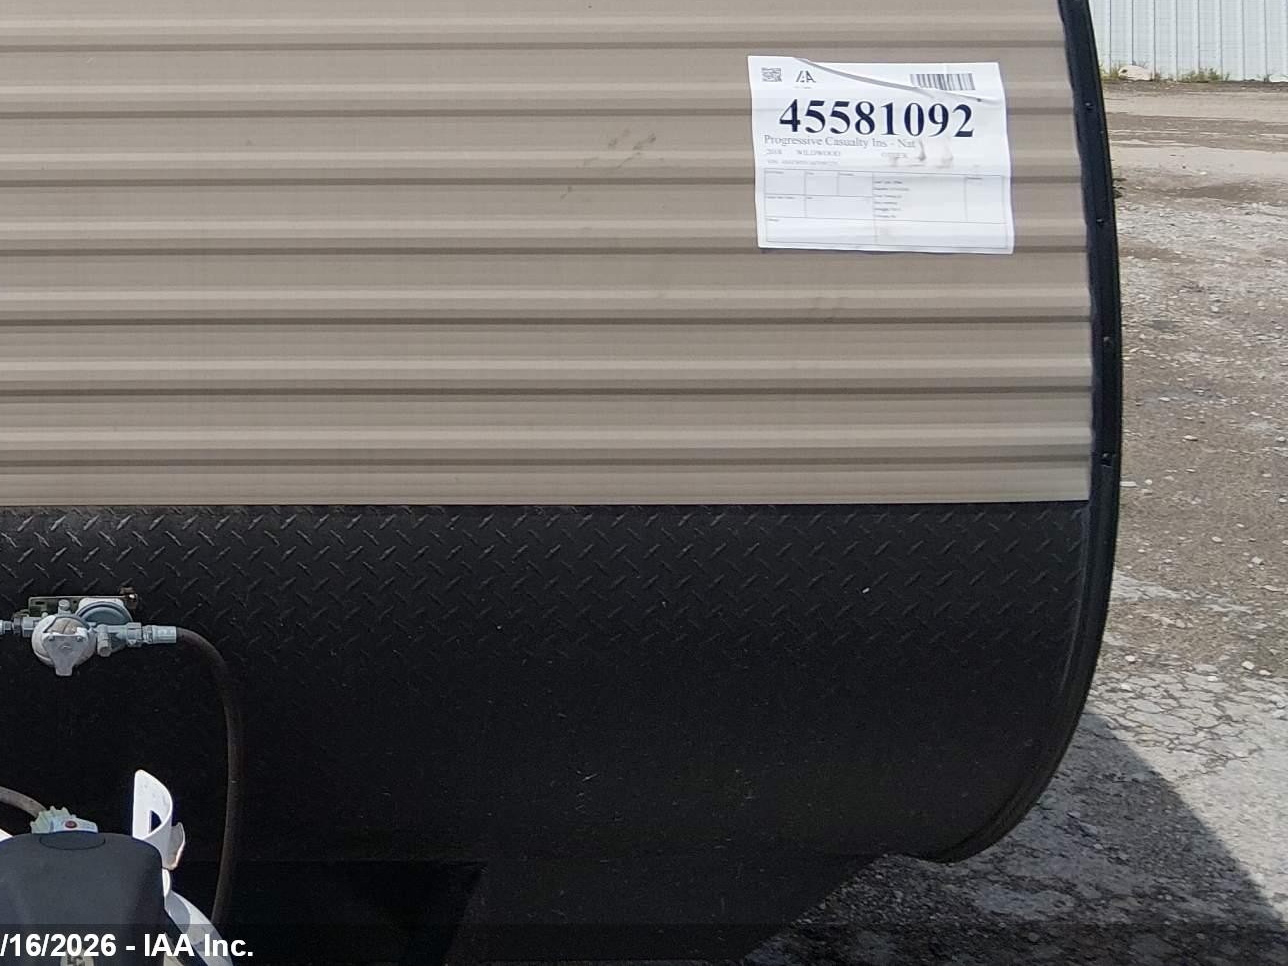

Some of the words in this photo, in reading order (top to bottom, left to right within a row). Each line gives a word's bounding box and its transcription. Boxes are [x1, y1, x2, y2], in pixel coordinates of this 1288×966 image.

[779, 99, 974, 138] 45581092
[764, 134, 823, 146] Progressive
[825, 136, 869, 148] Casualty
